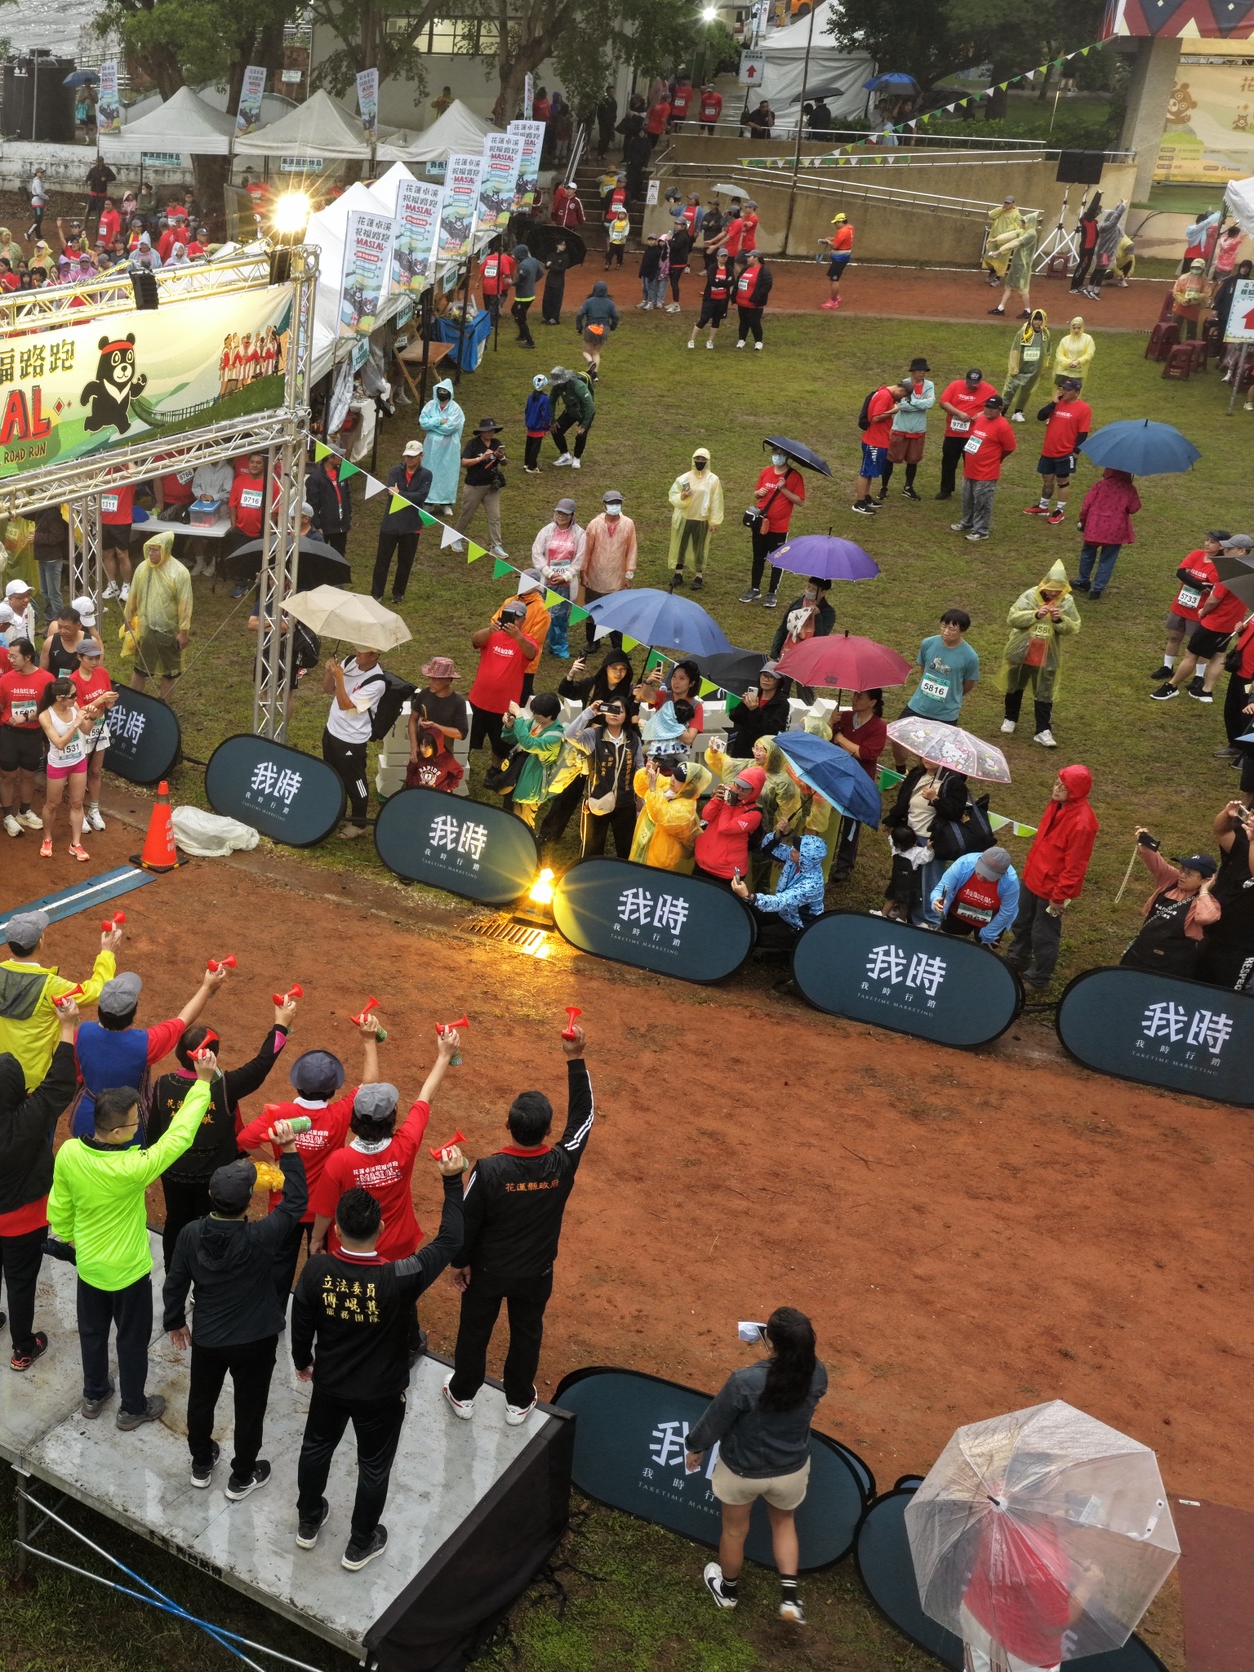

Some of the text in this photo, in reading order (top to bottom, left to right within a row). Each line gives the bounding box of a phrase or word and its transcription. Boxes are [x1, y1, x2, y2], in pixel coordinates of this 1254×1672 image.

[490, 153, 515, 162] MASIAL
[405, 203, 434, 216] MASIAL
[356, 237, 385, 251] MASIAL
[3, 447, 26, 464] ROAD
[28, 441, 48, 458] RUN
[923, 682, 945, 696] 5816
[106, 704, 146, 745] 我時
[61, 743, 80, 754] 1531
[251, 761, 303, 805] 我時
[428, 814, 488, 861] 我時
[617, 887, 689, 936] 我時
[610, 933, 679, 956] TAKETIME MARKETING
[865, 944, 947, 997] 我時
[857, 992, 935, 1018] TAKETIME MARKETING
[1141, 1001, 1234, 1055] 我時
[1131, 1050, 1219, 1076] TAKETIME MARKETING
[505, 1178, 560, 1193] 花蓮縣政府
[321, 1274, 377, 1299] 立法委員
[642, 1467, 715, 1502] 我時行
[638, 1481, 721, 1517] TAKETIME MARKE
